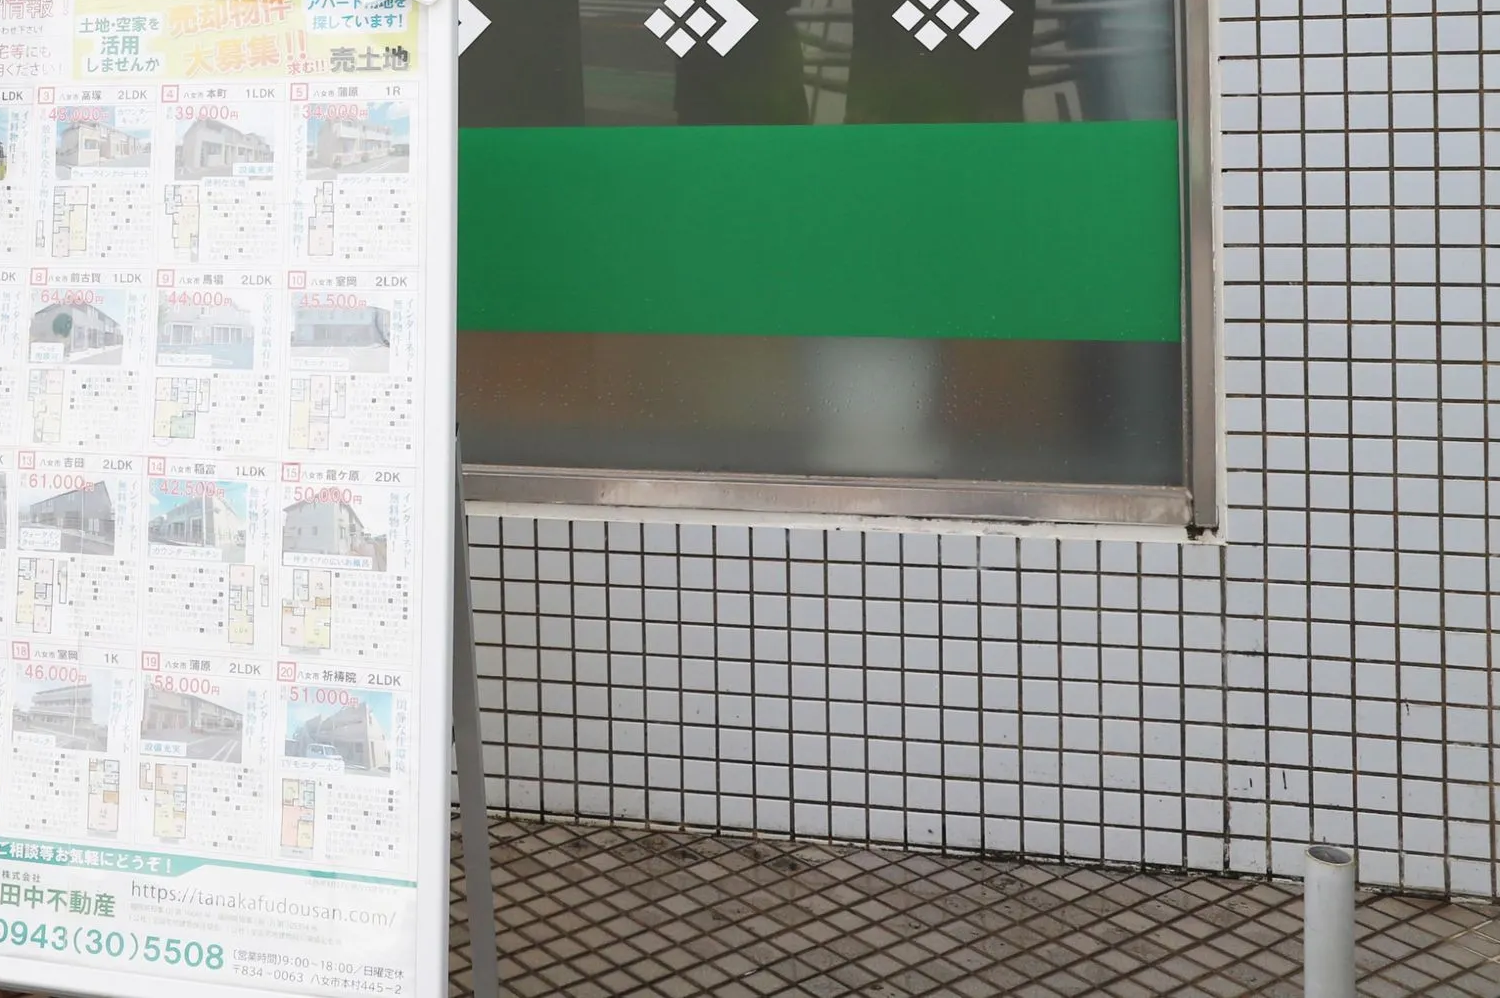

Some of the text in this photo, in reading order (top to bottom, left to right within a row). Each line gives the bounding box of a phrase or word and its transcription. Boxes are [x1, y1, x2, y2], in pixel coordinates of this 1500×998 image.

[79, 17, 160, 34] 土地・空家を
[100, 35, 139, 55] 活用
[87, 56, 160, 73] しませんか
[329, 45, 410, 72] 売土地
[43, 91, 49, 101] 3
[118, 90, 148, 100] 2LDK
[206, 88, 227, 98] 本町
[246, 88, 275, 98] 1LDK
[385, 86, 400, 96] 1R
[36, 272, 41, 282] 8
[114, 273, 142, 283] 1LDK
[162, 273, 169, 283] 9
[241, 274, 272, 285] 2LDK
[292, 276, 302, 285] 10
[375, 276, 408, 287] 2LDK
[40, 458, 60, 466] 八女市
[102, 459, 133, 470] 2LDK
[170, 465, 191, 473] 八女市
[235, 466, 266, 477] 1LDK
[29, 473, 95, 491] 61,000円
[375, 471, 401, 483] 2DK
[293, 487, 362, 505] 50,000円
[34, 650, 55, 658] 八女市
[103, 653, 119, 664] 1K
[25, 664, 87, 682] 46,000円
[146, 657, 156, 667] 19
[164, 661, 187, 669] 八女市
[229, 663, 261, 675] 2LDK
[280, 667, 292, 678] 20
[297, 671, 319, 680] 八女市
[367, 673, 401, 686] 2LDK
[290, 686, 359, 706] 51,000円
[2, 870, 41, 883] 株式会社
[0, 882, 116, 918] 田中不動産
[131, 880, 397, 928] https://tanakafudousan.com/
